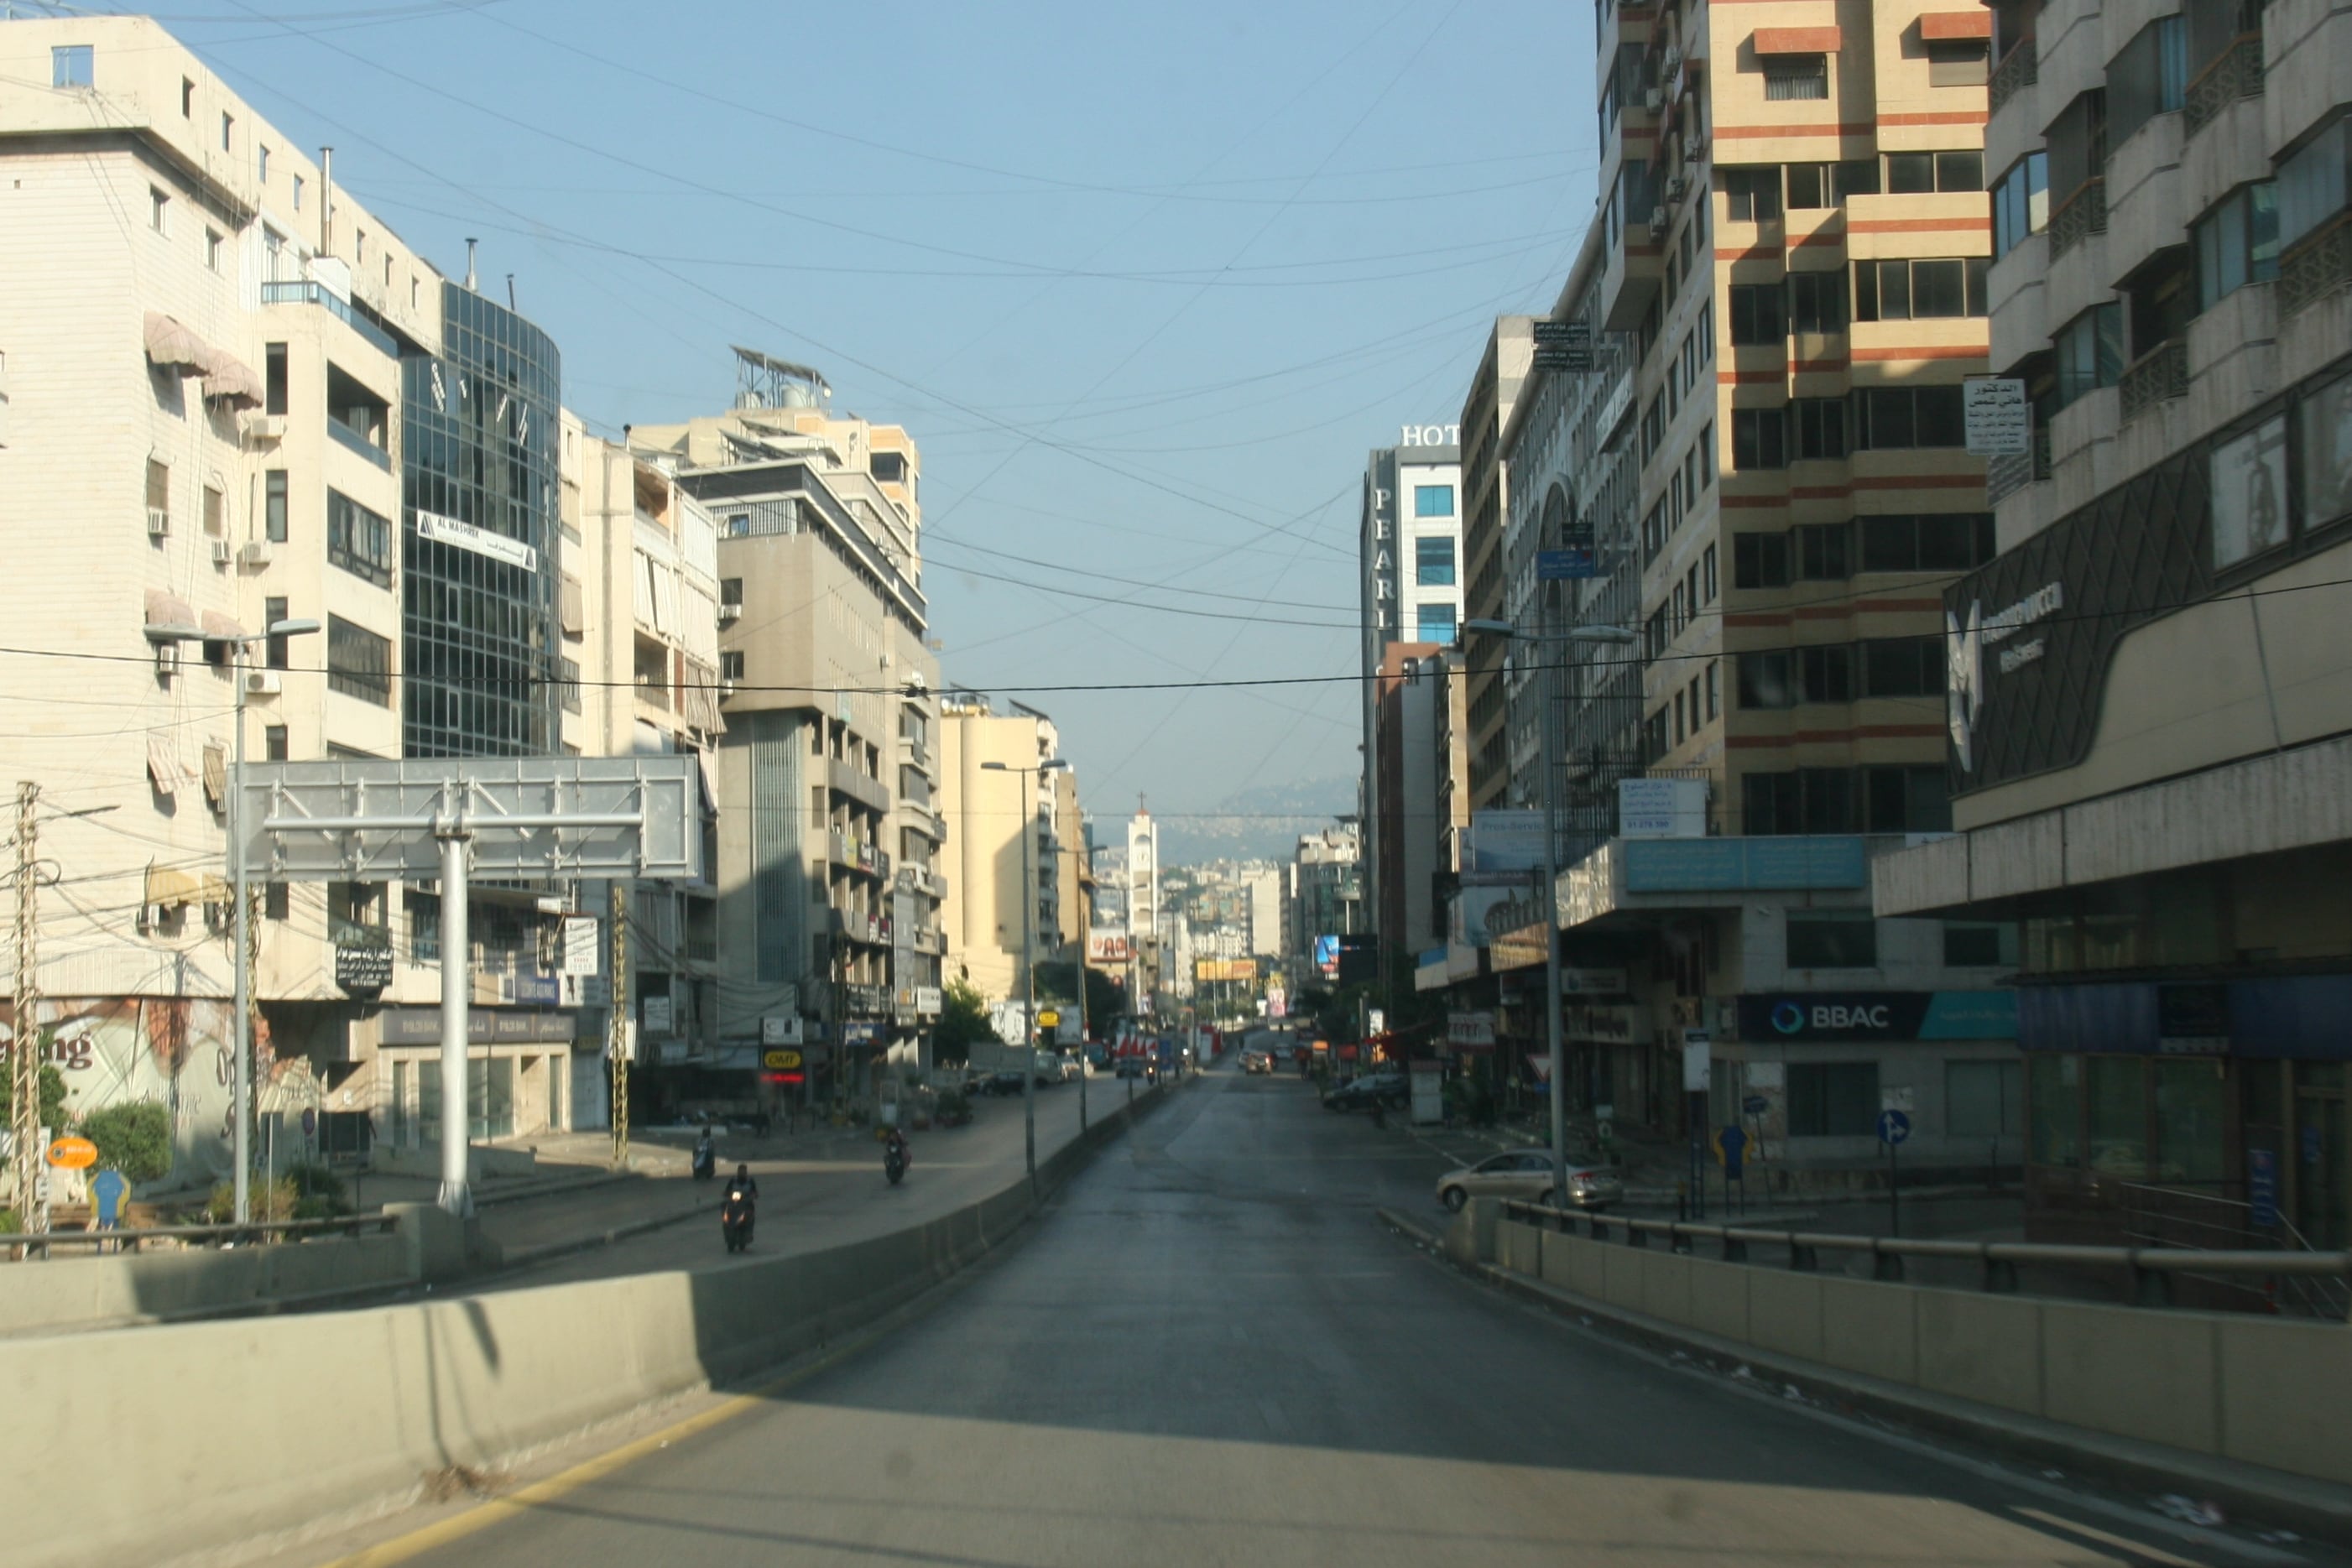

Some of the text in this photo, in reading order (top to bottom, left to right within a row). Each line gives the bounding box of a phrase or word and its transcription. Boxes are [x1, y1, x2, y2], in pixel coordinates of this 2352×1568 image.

[1974, 383, 2017, 395] الدكتور
[1374, 488, 1395, 632] PEARL
[1812, 1005, 1889, 1029] BBAC
[769, 1054, 795, 1065] OMT
